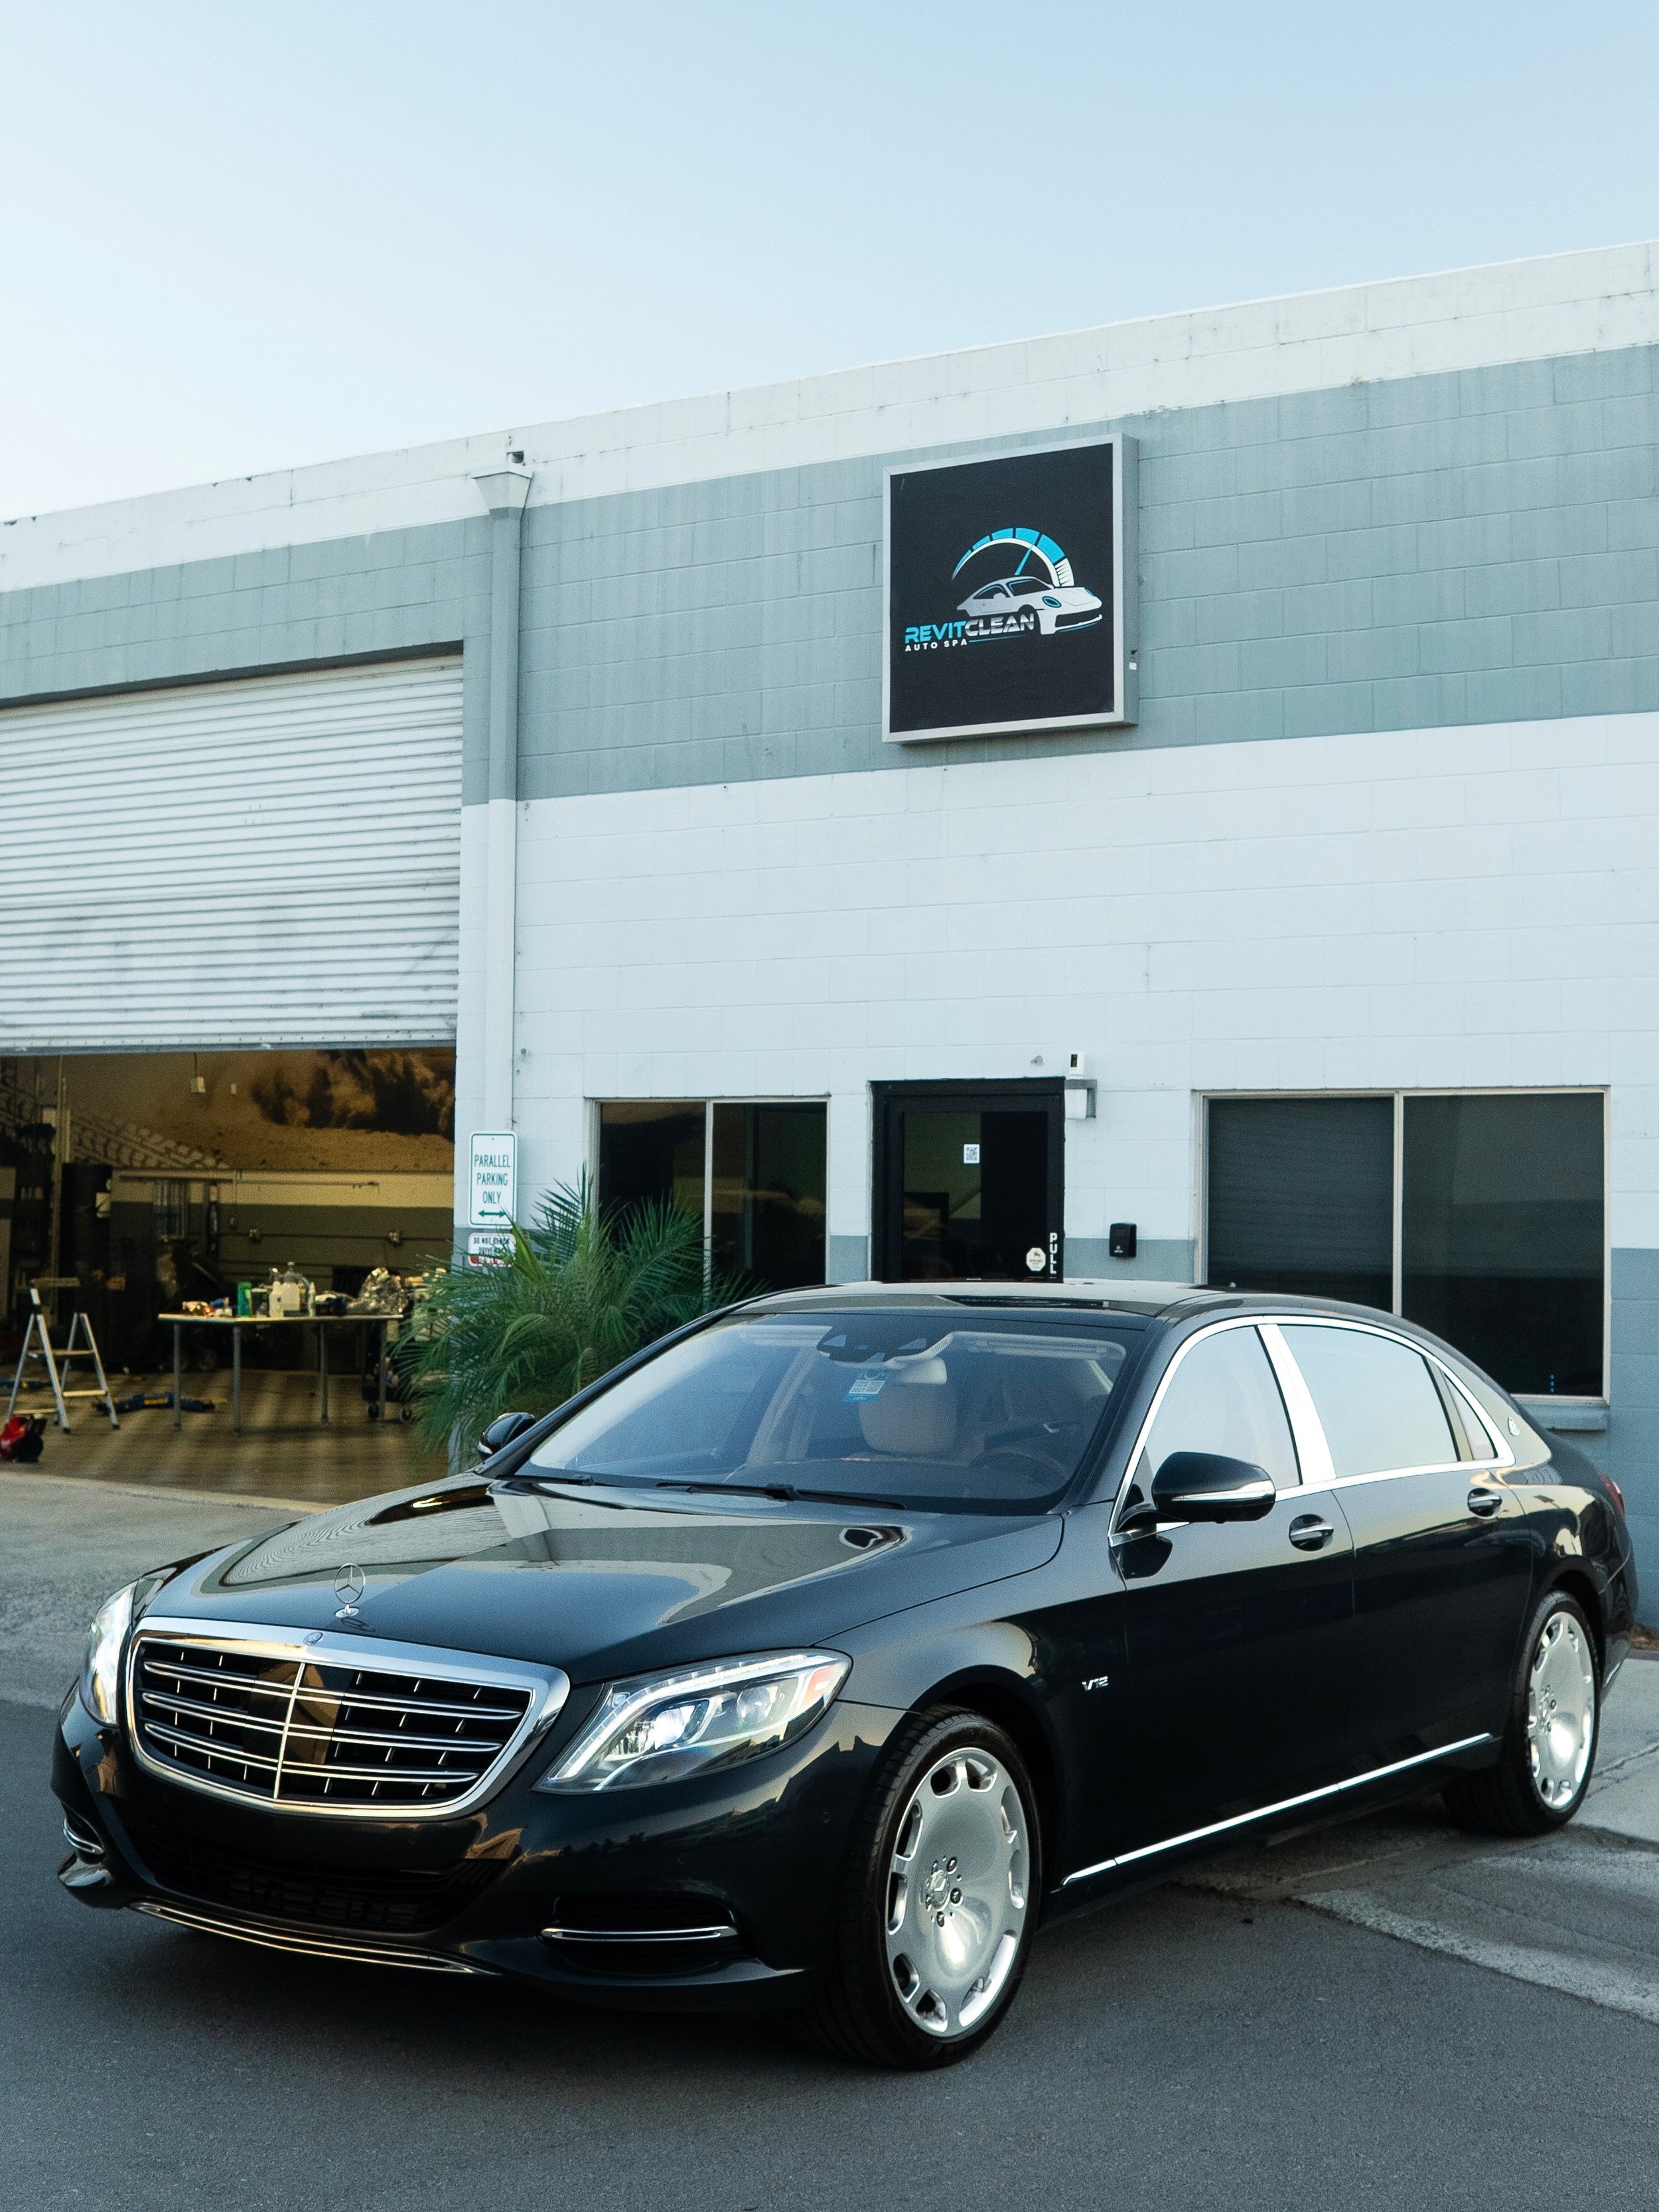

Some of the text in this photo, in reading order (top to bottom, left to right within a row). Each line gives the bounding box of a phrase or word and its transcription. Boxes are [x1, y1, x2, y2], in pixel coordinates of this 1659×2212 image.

[904, 638, 967, 652] AUTO SPA
[474, 1155, 510, 1167] PARALLEL
[477, 1173, 508, 1185] PARKING
[482, 1191, 501, 1204] ONLY
